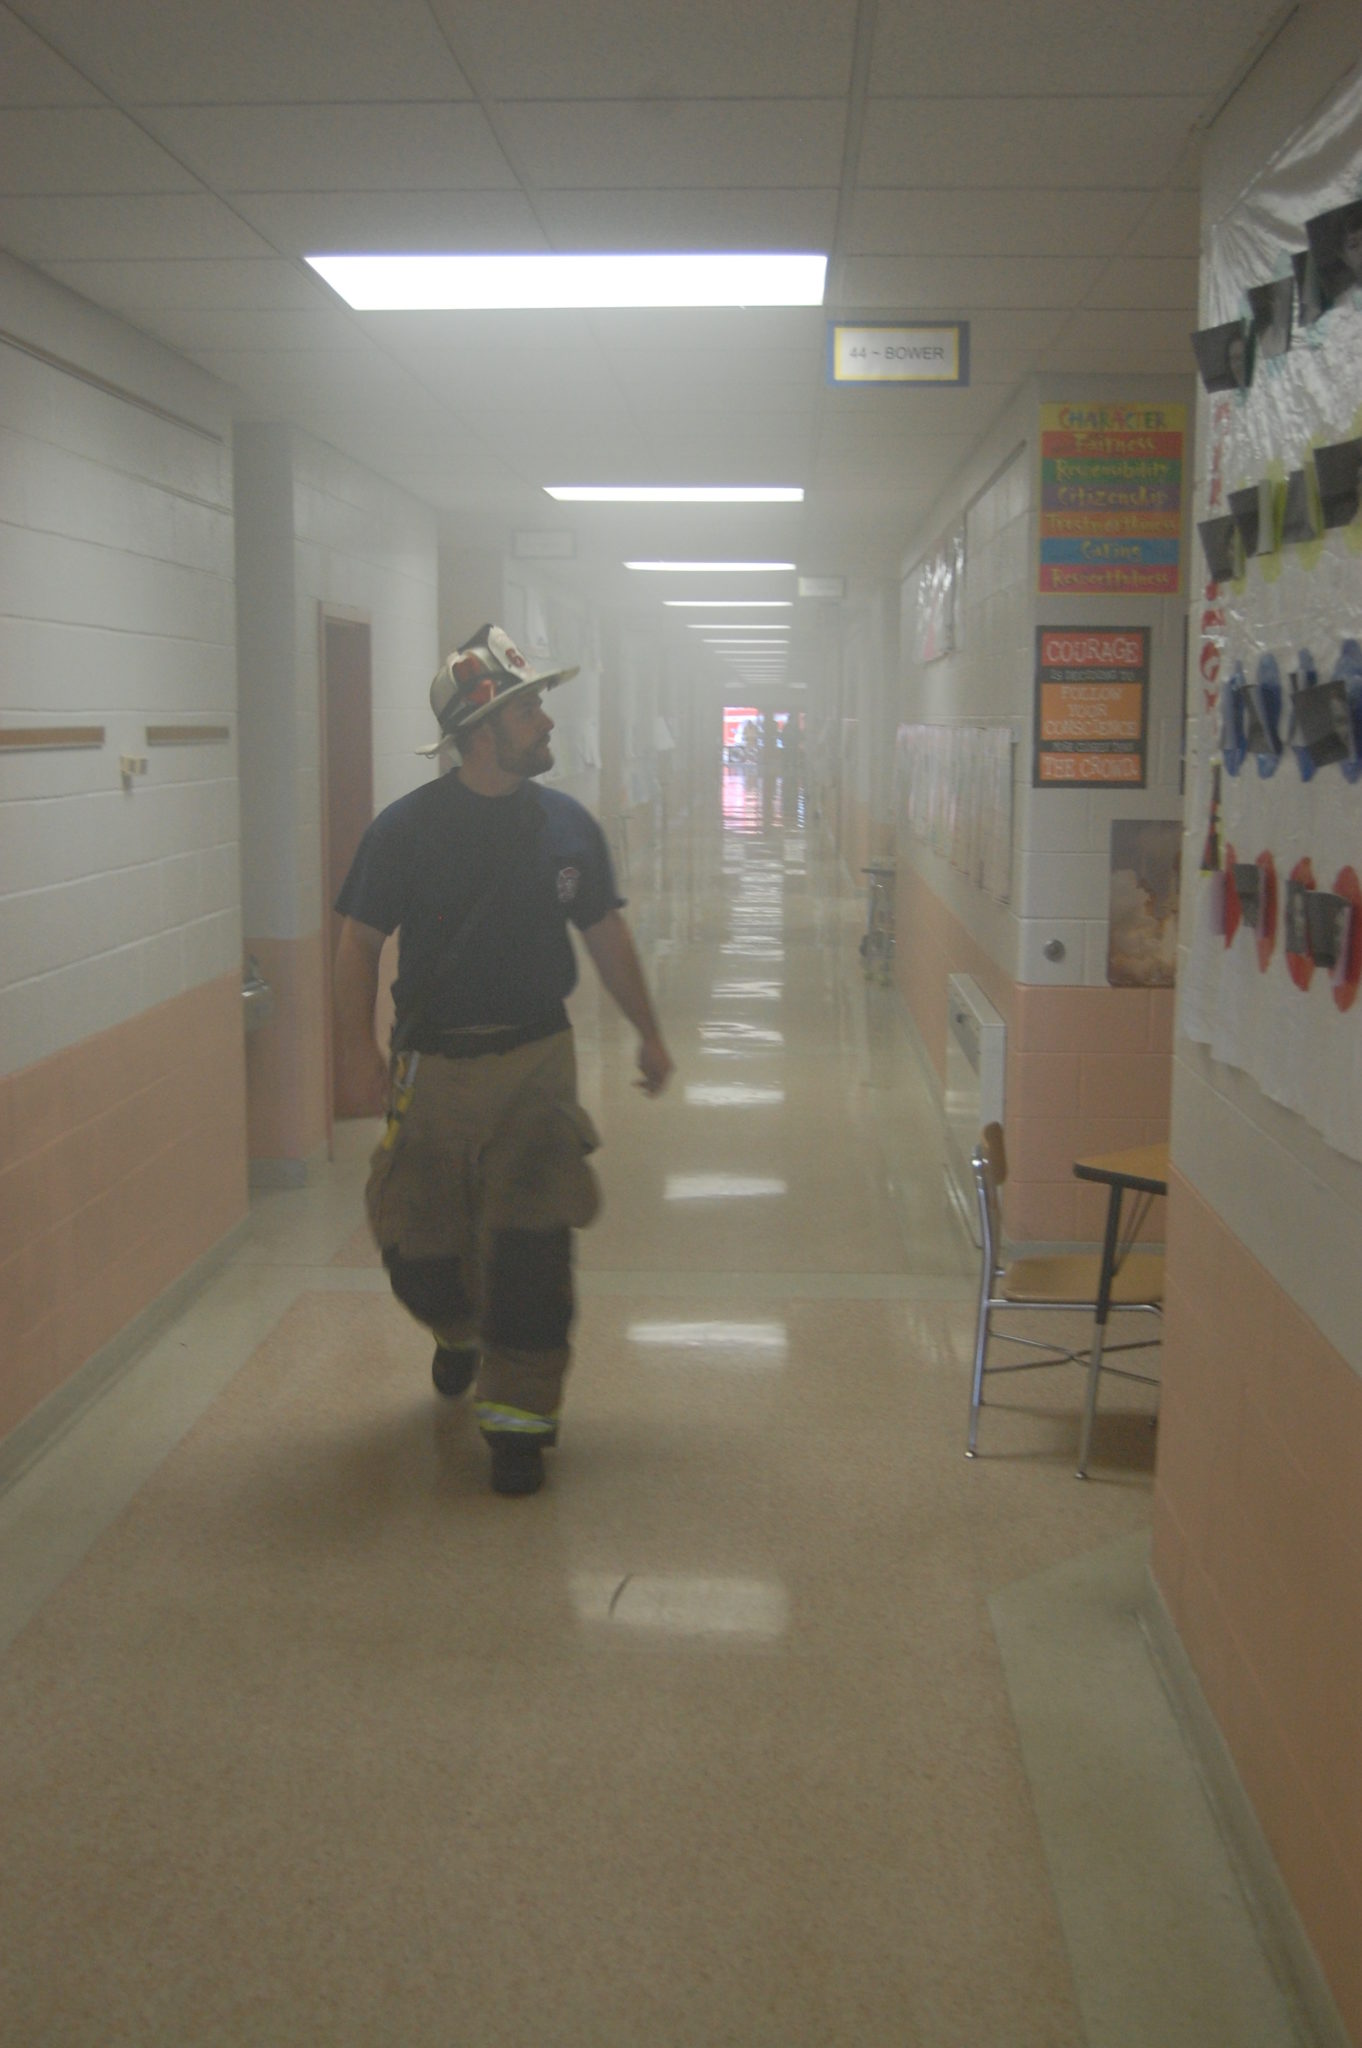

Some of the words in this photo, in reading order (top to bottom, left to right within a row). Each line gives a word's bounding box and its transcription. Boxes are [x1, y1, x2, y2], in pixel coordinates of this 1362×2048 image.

[849, 347, 867, 359] 44
[885, 346, 945, 361] BOWER
[1058, 404, 1168, 430] CHARACTER
[1073, 432, 1157, 453] Fairness
[1057, 486, 1168, 506] Citizenship
[1080, 540, 1143, 561] Caring
[1046, 637, 1138, 663] COURAGE
[1061, 686, 1123, 700] FOLLOW
[1066, 703, 1108, 718] YOUR
[1045, 719, 1137, 736] CONSCIENCE
[1043, 756, 1075, 778] THE
